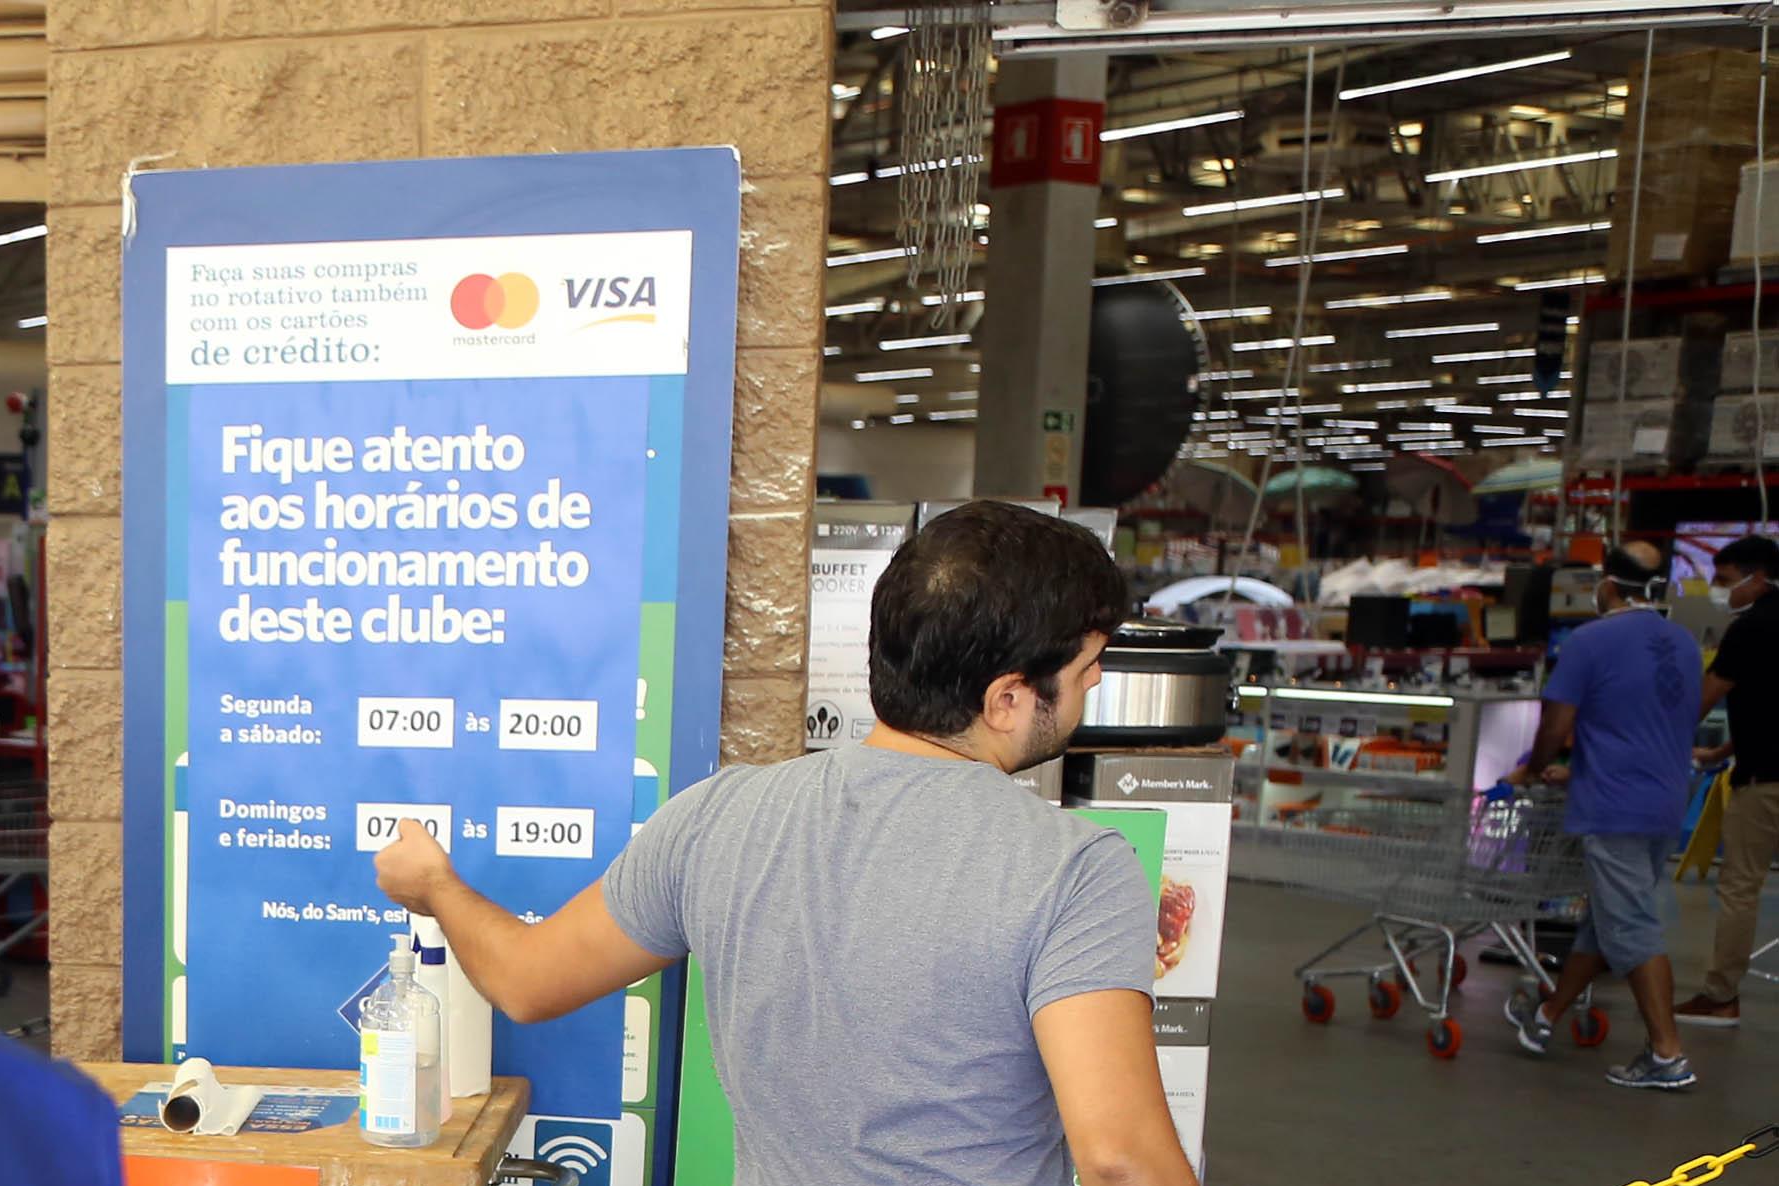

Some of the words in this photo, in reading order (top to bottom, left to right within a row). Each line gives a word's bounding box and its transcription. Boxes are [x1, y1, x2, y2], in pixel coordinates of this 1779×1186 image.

[190, 263, 244, 287] Faça
[251, 264, 306, 281] suas
[313, 261, 418, 283] compras
[190, 292, 219, 308] no
[228, 286, 323, 307] rotativo
[332, 282, 428, 303] também
[564, 275, 657, 309] VISA
[189, 317, 238, 332] com
[246, 316, 273, 331] os
[280, 310, 369, 330] cartões
[190, 339, 231, 366] de
[243, 336, 381, 365] crédito:
[452, 332, 536, 347] mastercard
[221, 423, 354, 485] Fique
[361, 424, 525, 473] atento
[221, 491, 305, 531] aos
[315, 480, 518, 531] horários
[527, 478, 592, 530] de
[219, 537, 590, 587] funcionamento
[812, 563, 867, 576] BUFFET
[219, 593, 353, 643] deste
[360, 593, 506, 644] clube:
[220, 694, 313, 719] Segunda
[220, 728, 233, 743] a
[238, 724, 322, 745] sábado:
[369, 709, 442, 732] 07:00
[465, 711, 491, 733] às
[509, 713, 583, 737] 20:00
[1141, 778, 1185, 789] Member's
[219, 799, 327, 824] Domingos
[219, 833, 232, 847] e
[237, 828, 331, 851] feriados:
[367, 816, 439, 839] 070
[463, 817, 488, 839] às
[510, 821, 584, 845] 19:00
[262, 900, 300, 922] Nós,
[303, 902, 322, 920] do
[326, 903, 381, 925] Sam's,
